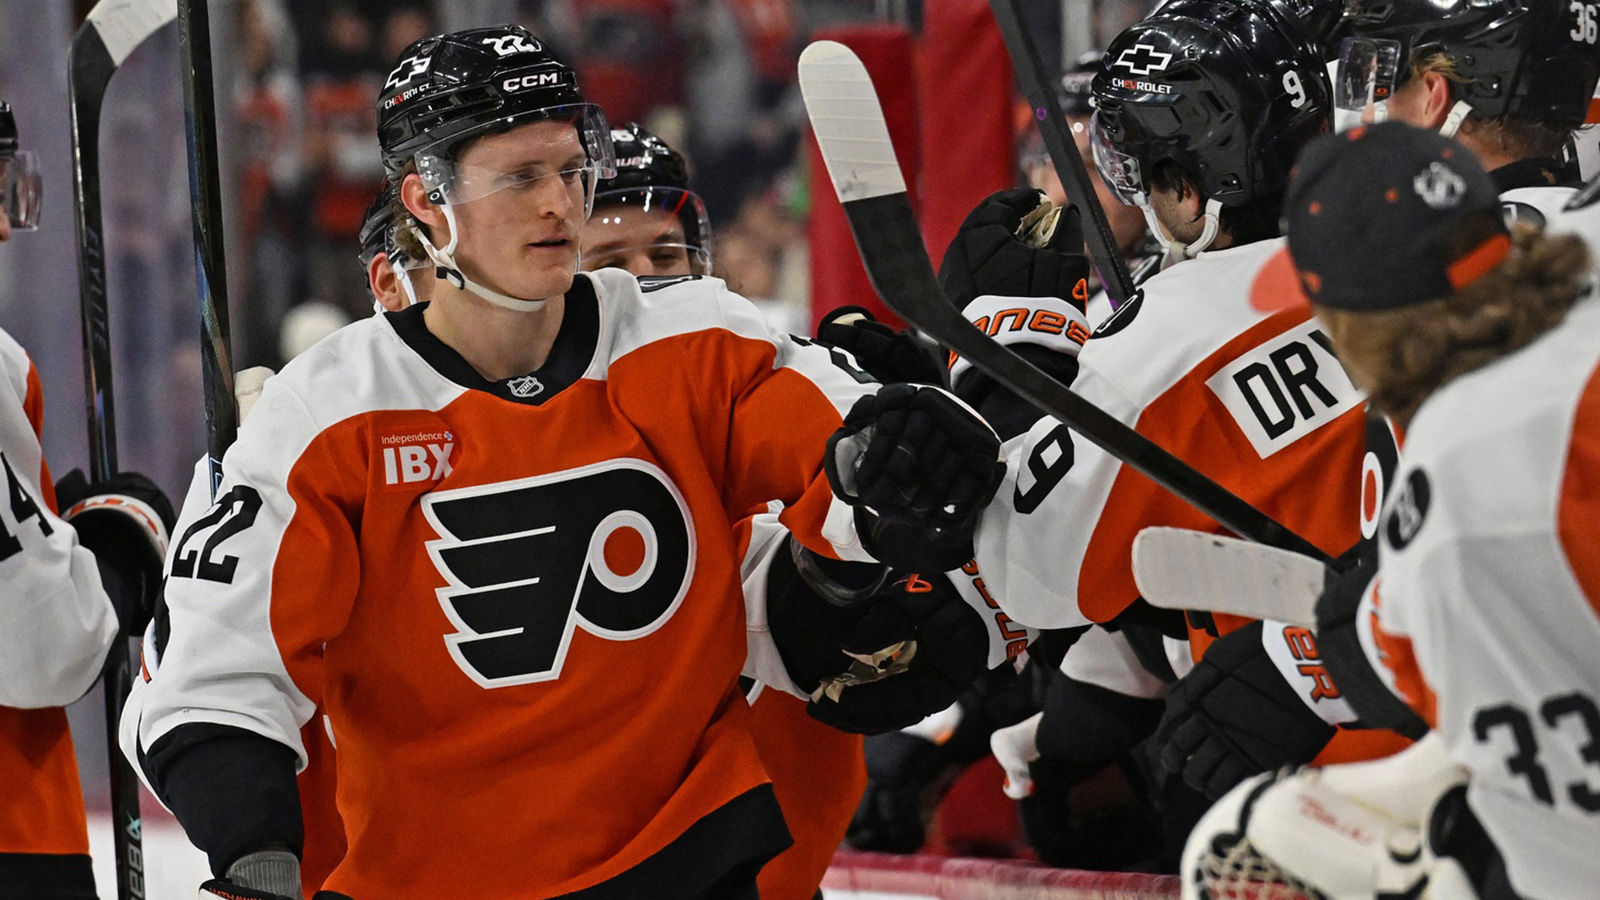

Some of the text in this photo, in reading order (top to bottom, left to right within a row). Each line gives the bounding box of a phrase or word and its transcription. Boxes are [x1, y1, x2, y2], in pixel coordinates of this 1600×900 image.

[1570, 0, 1598, 45] 36
[482, 35, 542, 56] 22
[503, 72, 558, 93] CCM
[1112, 77, 1172, 94] CHEVROLET
[1282, 69, 1307, 109] 9
[381, 431, 443, 445] Independence
[383, 443, 454, 485] IBX
[1013, 423, 1075, 515] 9
[170, 485, 263, 585] 22
